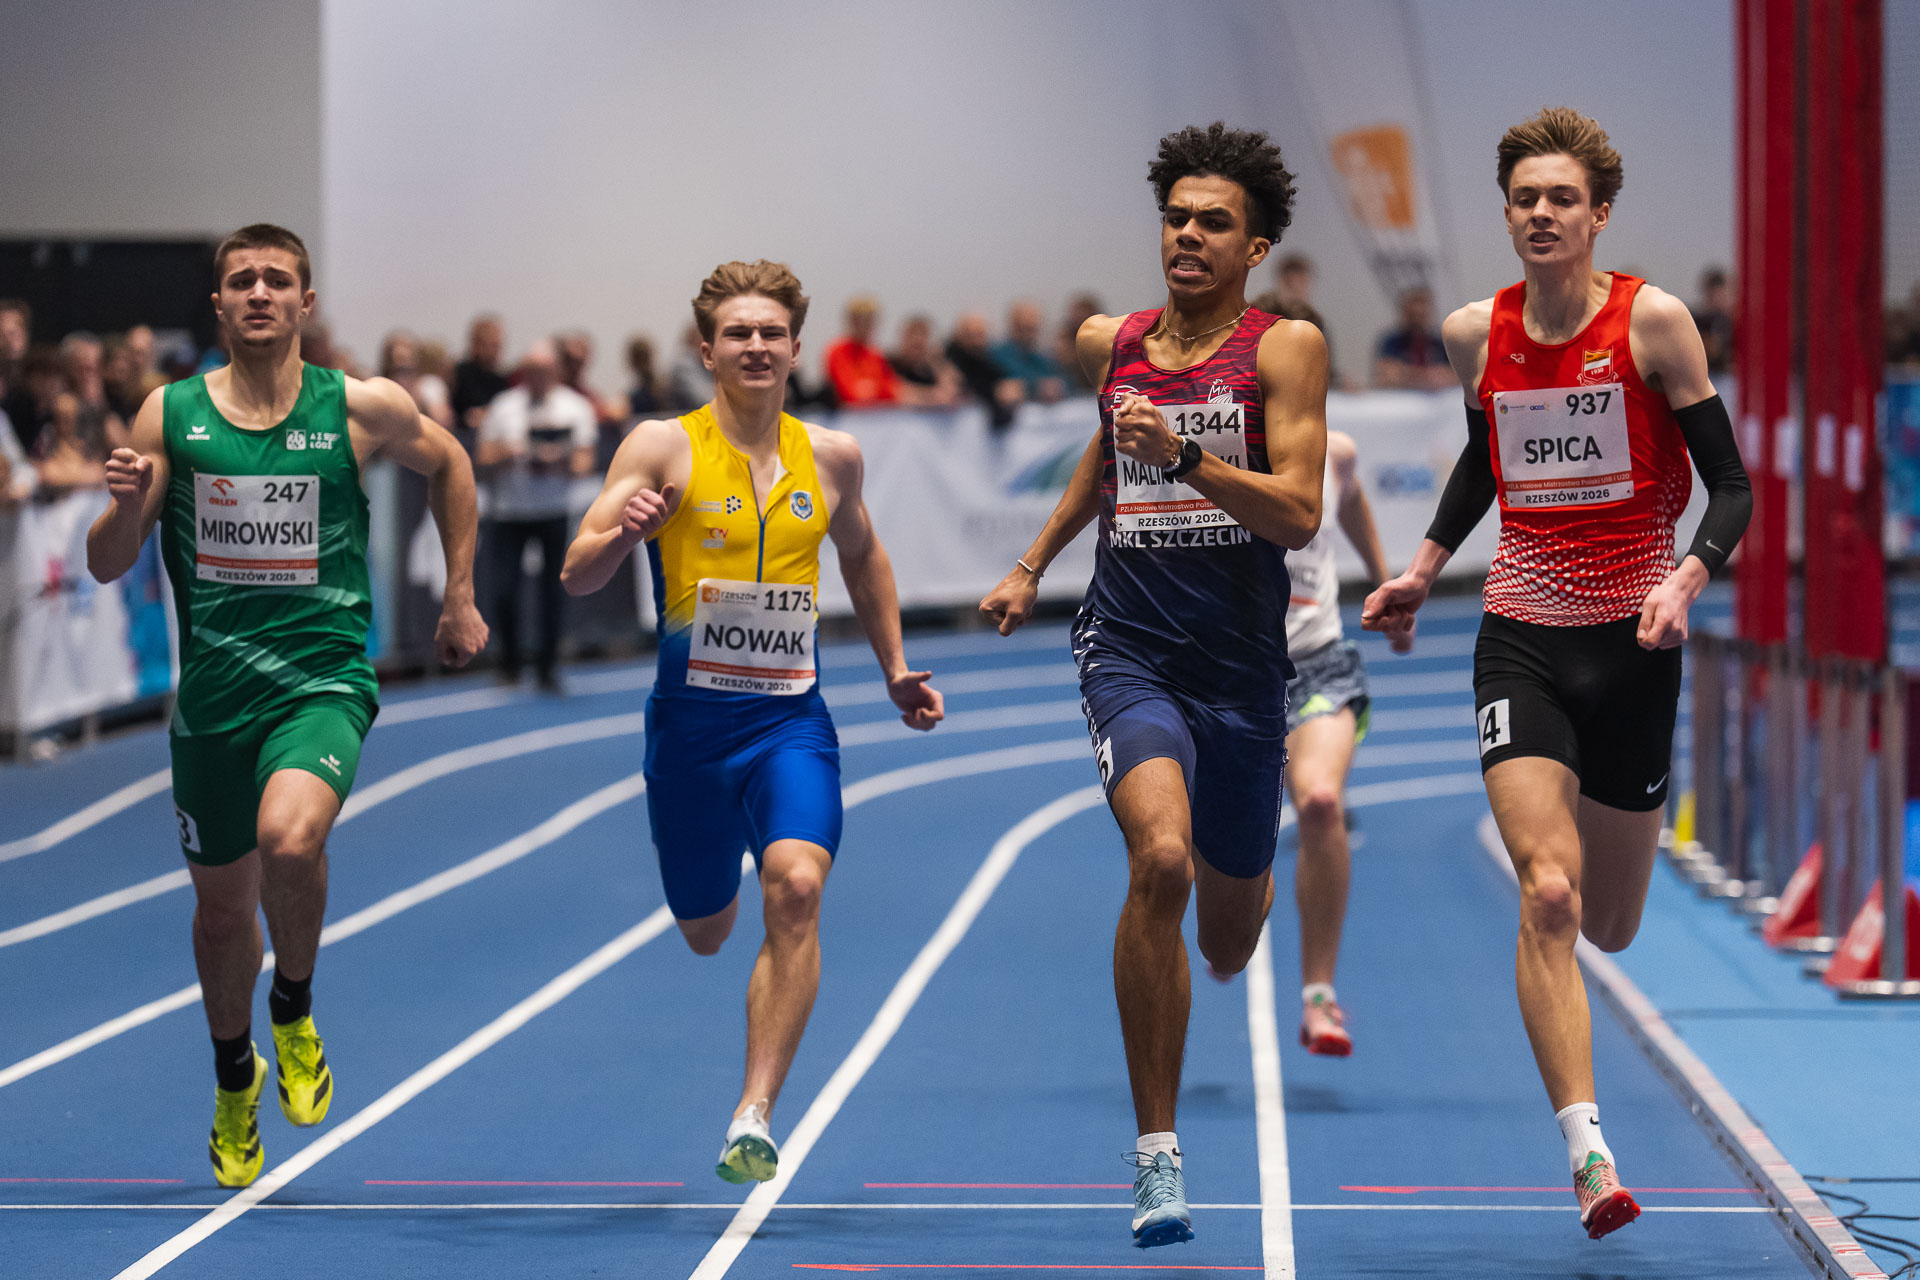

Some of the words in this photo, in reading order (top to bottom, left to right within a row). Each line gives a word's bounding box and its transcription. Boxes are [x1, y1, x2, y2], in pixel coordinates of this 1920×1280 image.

[1565, 391, 1612, 417] 937
[1175, 411, 1241, 436] 1344
[1524, 435, 1603, 465] SPICA
[208, 496, 238, 507] ORLEN
[263, 481, 309, 503] 247
[1525, 491, 1578, 504] RZESZÓW
[1581, 488, 1610, 500] 2026
[1134, 504, 1157, 512] Halowe
[1157, 502, 1194, 511] Mistrzostwa
[1195, 500, 1216, 508] Polsk
[1138, 514, 1192, 527] RZESZÓW
[1195, 512, 1226, 524] 2026
[201, 517, 312, 545] MIROWSKI
[1109, 530, 1146, 548] MKL
[1150, 527, 1252, 548] SZCZECIN
[215, 570, 267, 582] RZESZÓW
[269, 572, 296, 582] 2026
[764, 589, 811, 612] 1175
[703, 623, 805, 655] NOWAK
[710, 676, 765, 690] RZESZÓW
[767, 682, 792, 691] 2026
[1482, 705, 1501, 745] 4
[177, 810, 191, 844] 3
